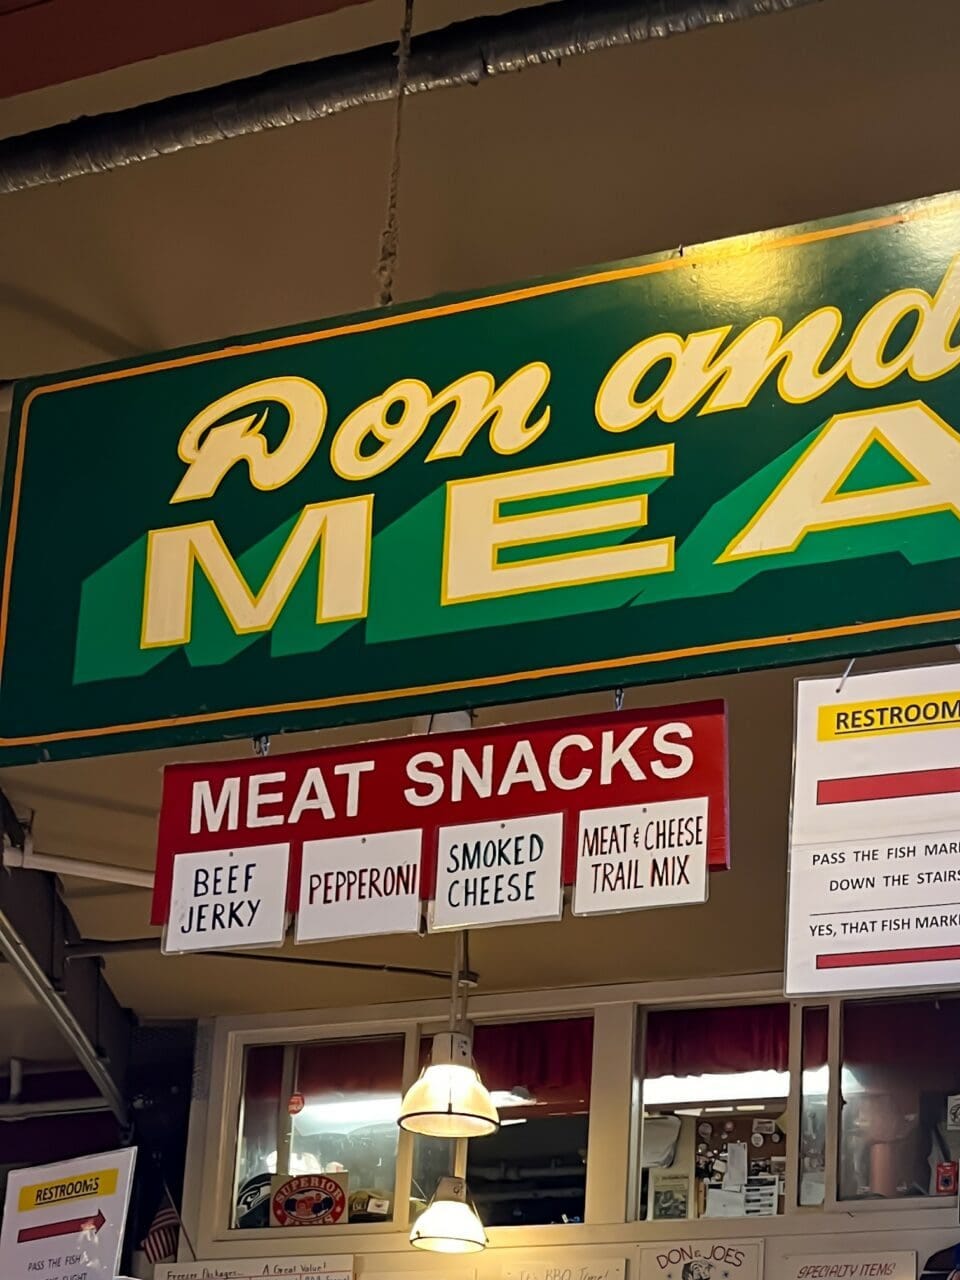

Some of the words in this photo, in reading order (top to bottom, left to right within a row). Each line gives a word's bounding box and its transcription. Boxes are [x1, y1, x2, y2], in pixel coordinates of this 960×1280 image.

[169, 361, 552, 504] Don
[190, 761, 375, 834] MEAT
[404, 721, 694, 807] SNACKS
[447, 833, 544, 873] SMOKED
[582, 823, 629, 857] MEAT
[632, 826, 641, 850] &
[644, 815, 704, 851] CHEESE
[591, 859, 644, 894] TRAIL
[651, 854, 690, 887] MIX
[812, 852, 846, 866] PASS
[853, 849, 879, 862] THE
[887, 846, 916, 860] FISH
[193, 863, 257, 897] BEEF
[308, 862, 417, 906] PEPPERONI
[448, 871, 536, 908] CHEESE
[829, 877, 875, 892] DOWN
[883, 874, 910, 888] THE
[181, 899, 261, 934] JERKY
[809, 924, 837, 938] YES,
[841, 921, 876, 934] THAT
[881, 919, 911, 932] FISH
[35, 1177, 99, 1202] RESTROOMS
[276, 1176, 342, 1204] SUPERIOR
